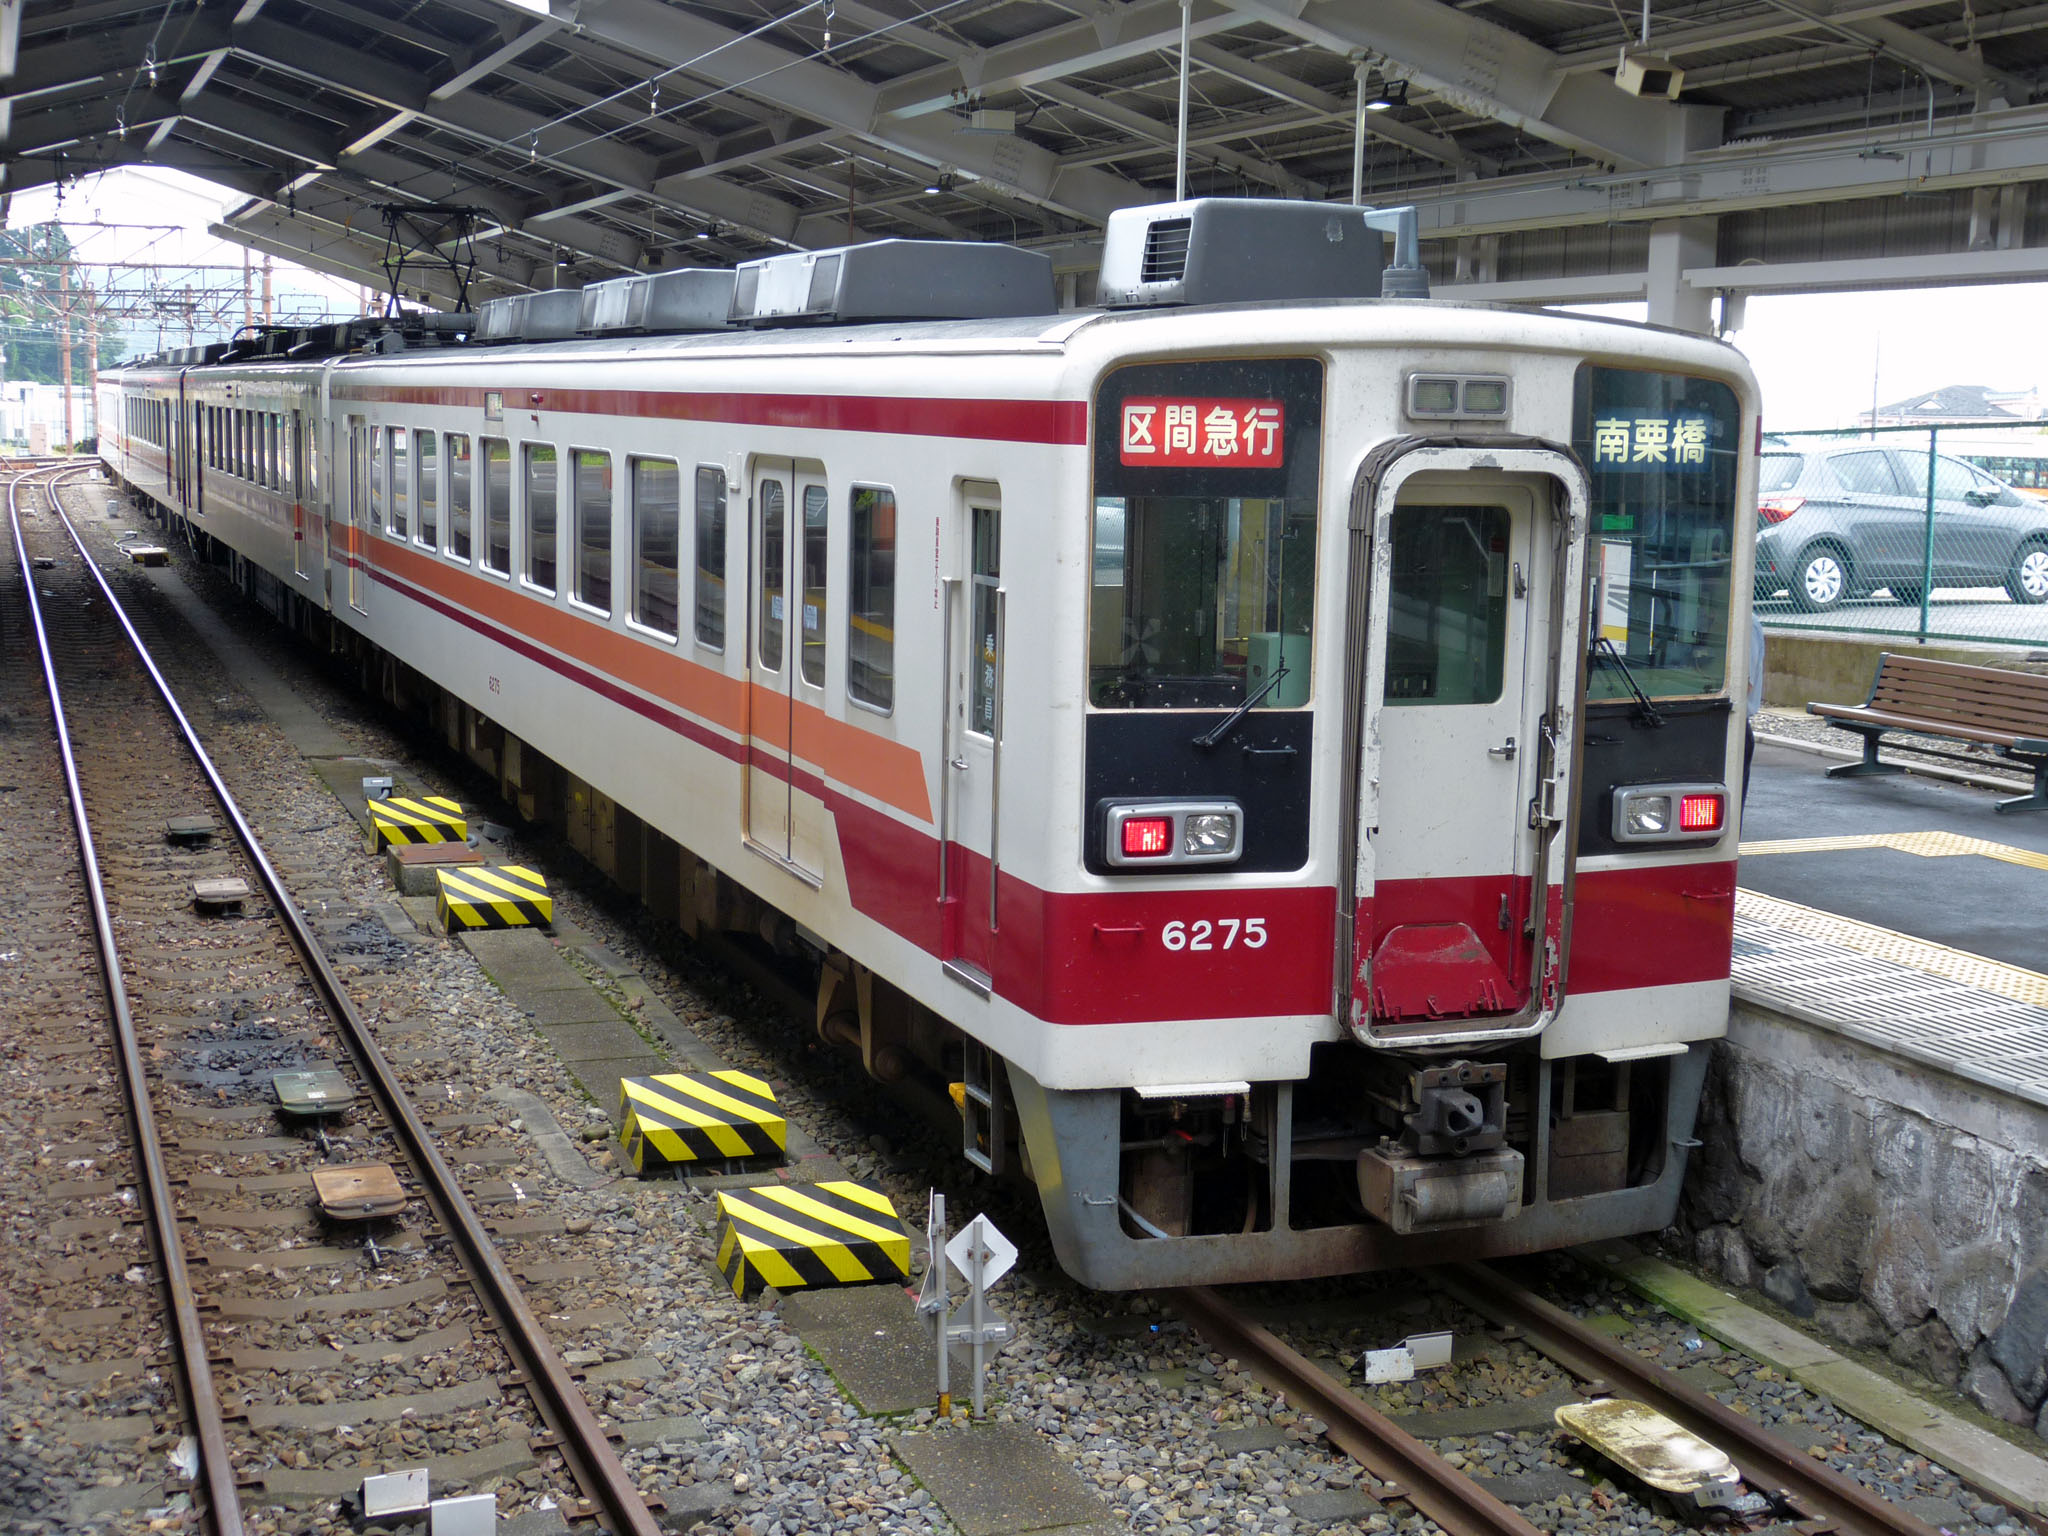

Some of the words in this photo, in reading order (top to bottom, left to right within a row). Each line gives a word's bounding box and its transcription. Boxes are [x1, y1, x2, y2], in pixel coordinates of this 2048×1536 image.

[1123, 404, 1280, 456] 区間急行
[1594, 416, 1707, 464] 南栗橋
[488, 675, 500, 695] 6275
[1161, 917, 1268, 951] 6275
